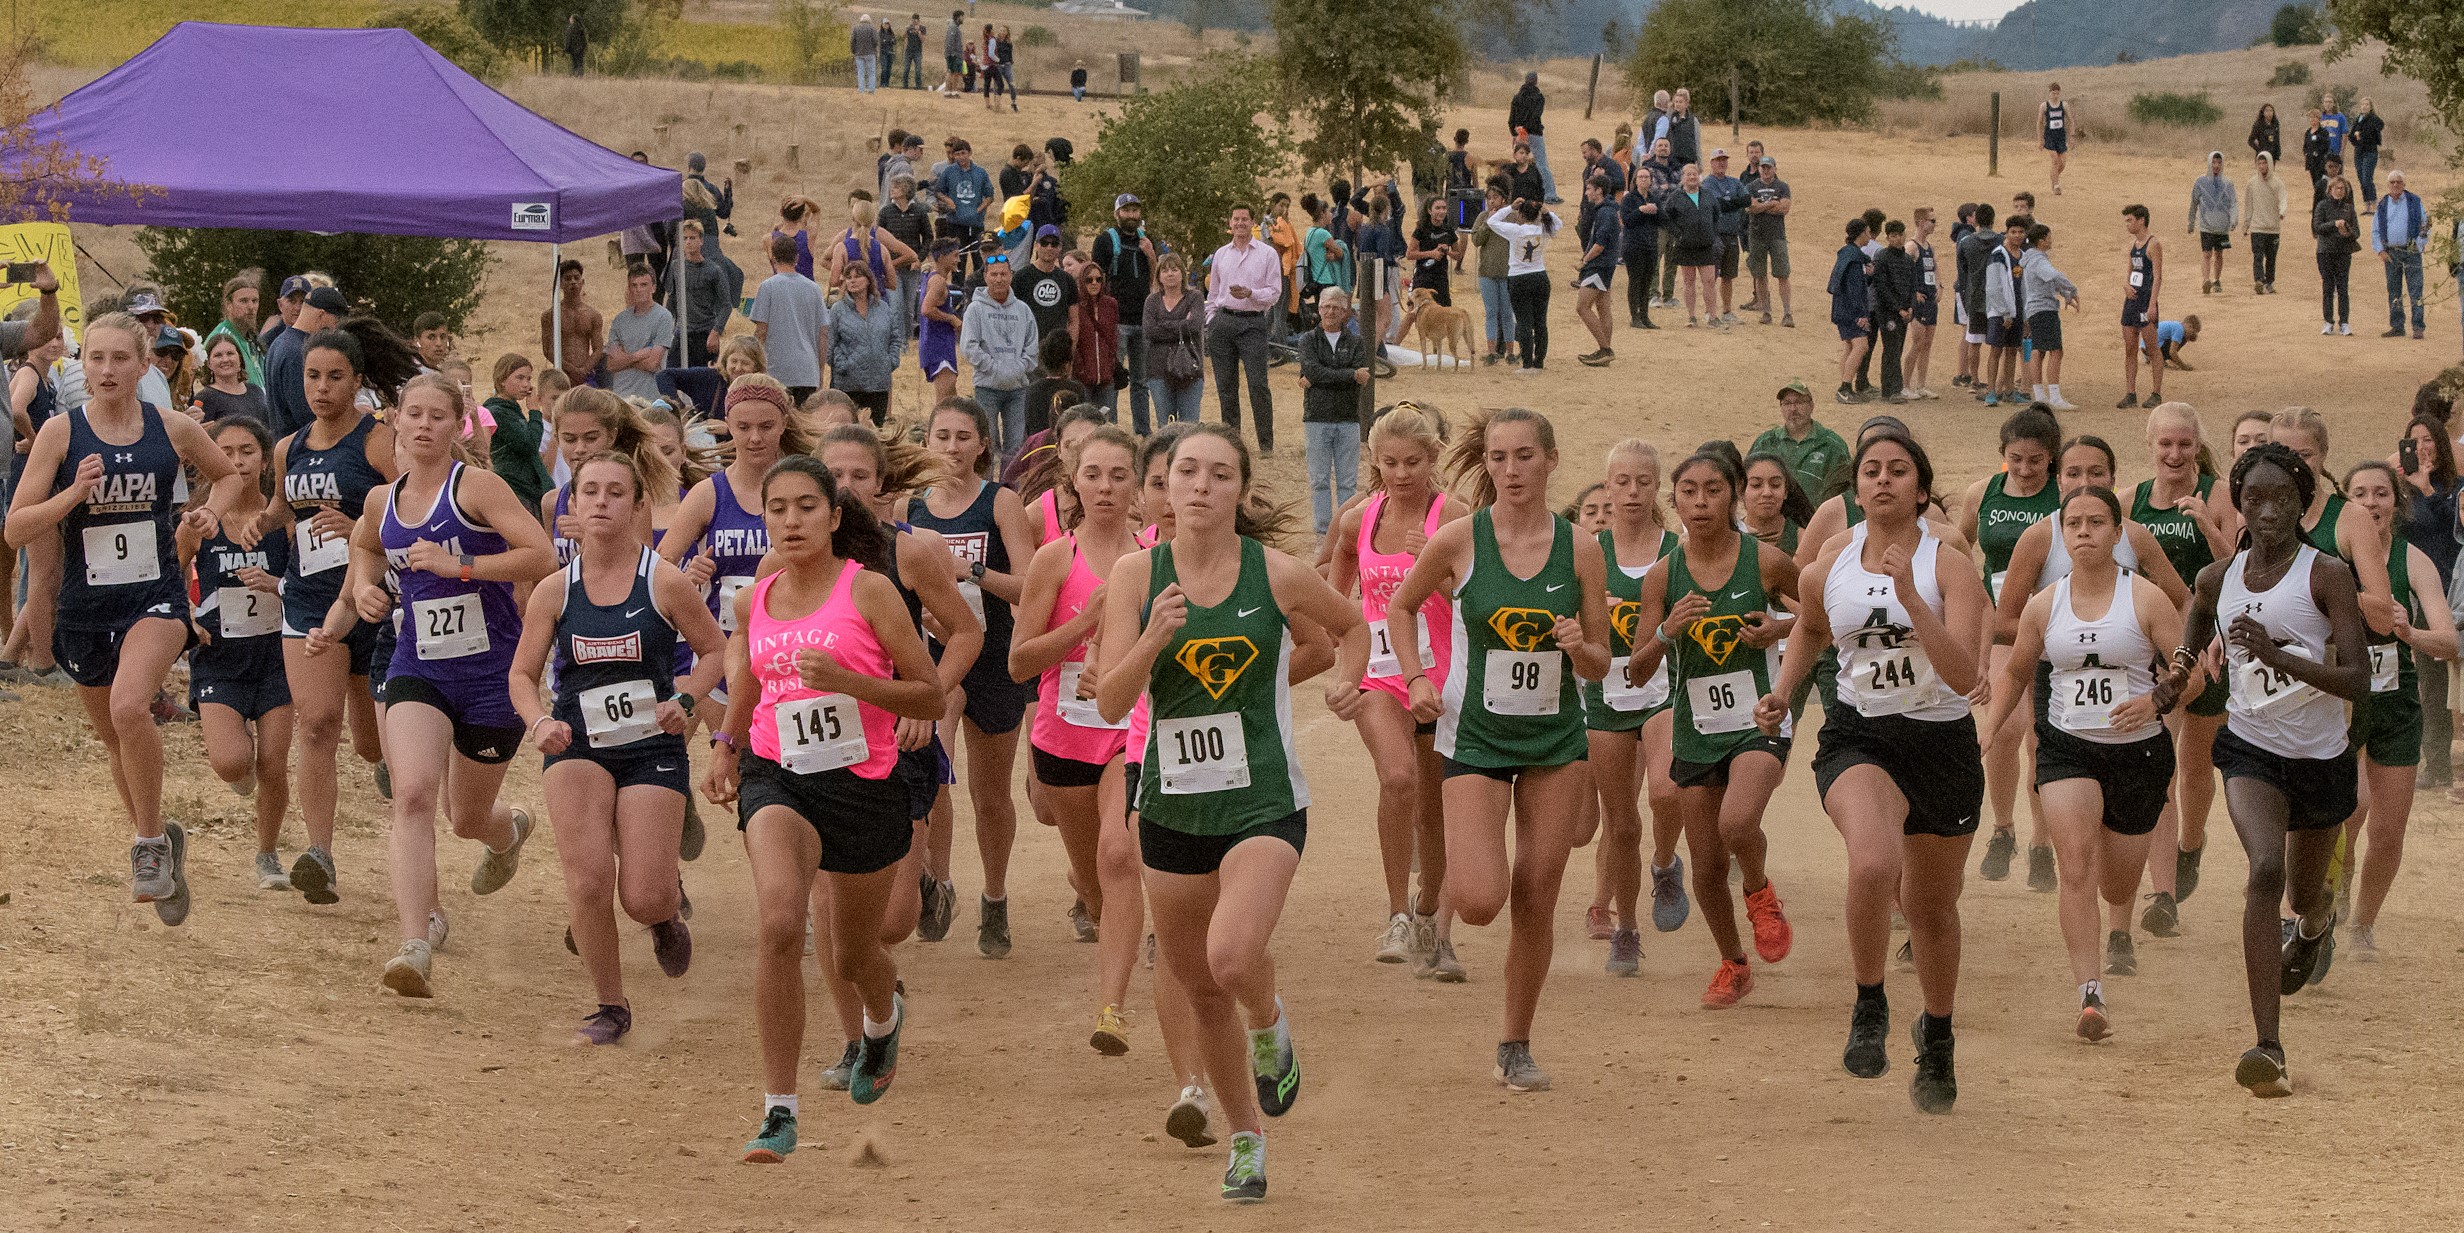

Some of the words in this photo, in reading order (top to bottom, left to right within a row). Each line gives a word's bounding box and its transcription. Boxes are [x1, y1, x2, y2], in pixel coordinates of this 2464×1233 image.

[85, 472, 158, 504] NAPA
[284, 472, 343, 502] NAPA
[114, 533, 128, 560] 9
[218, 551, 271, 573] NAPA
[246, 594, 258, 617] 2
[427, 604, 465, 637] 227
[575, 636, 638, 661] BRAVES
[1511, 661, 1541, 690] 98
[1622, 664, 1635, 690] 9
[1869, 655, 1916, 690] 244
[2253, 667, 2298, 697] 24
[1708, 682, 1736, 711] 96
[2074, 677, 2113, 706] 246
[604, 692, 635, 723] 66
[791, 704, 842, 746] 145
[1174, 725, 1226, 766] 100
